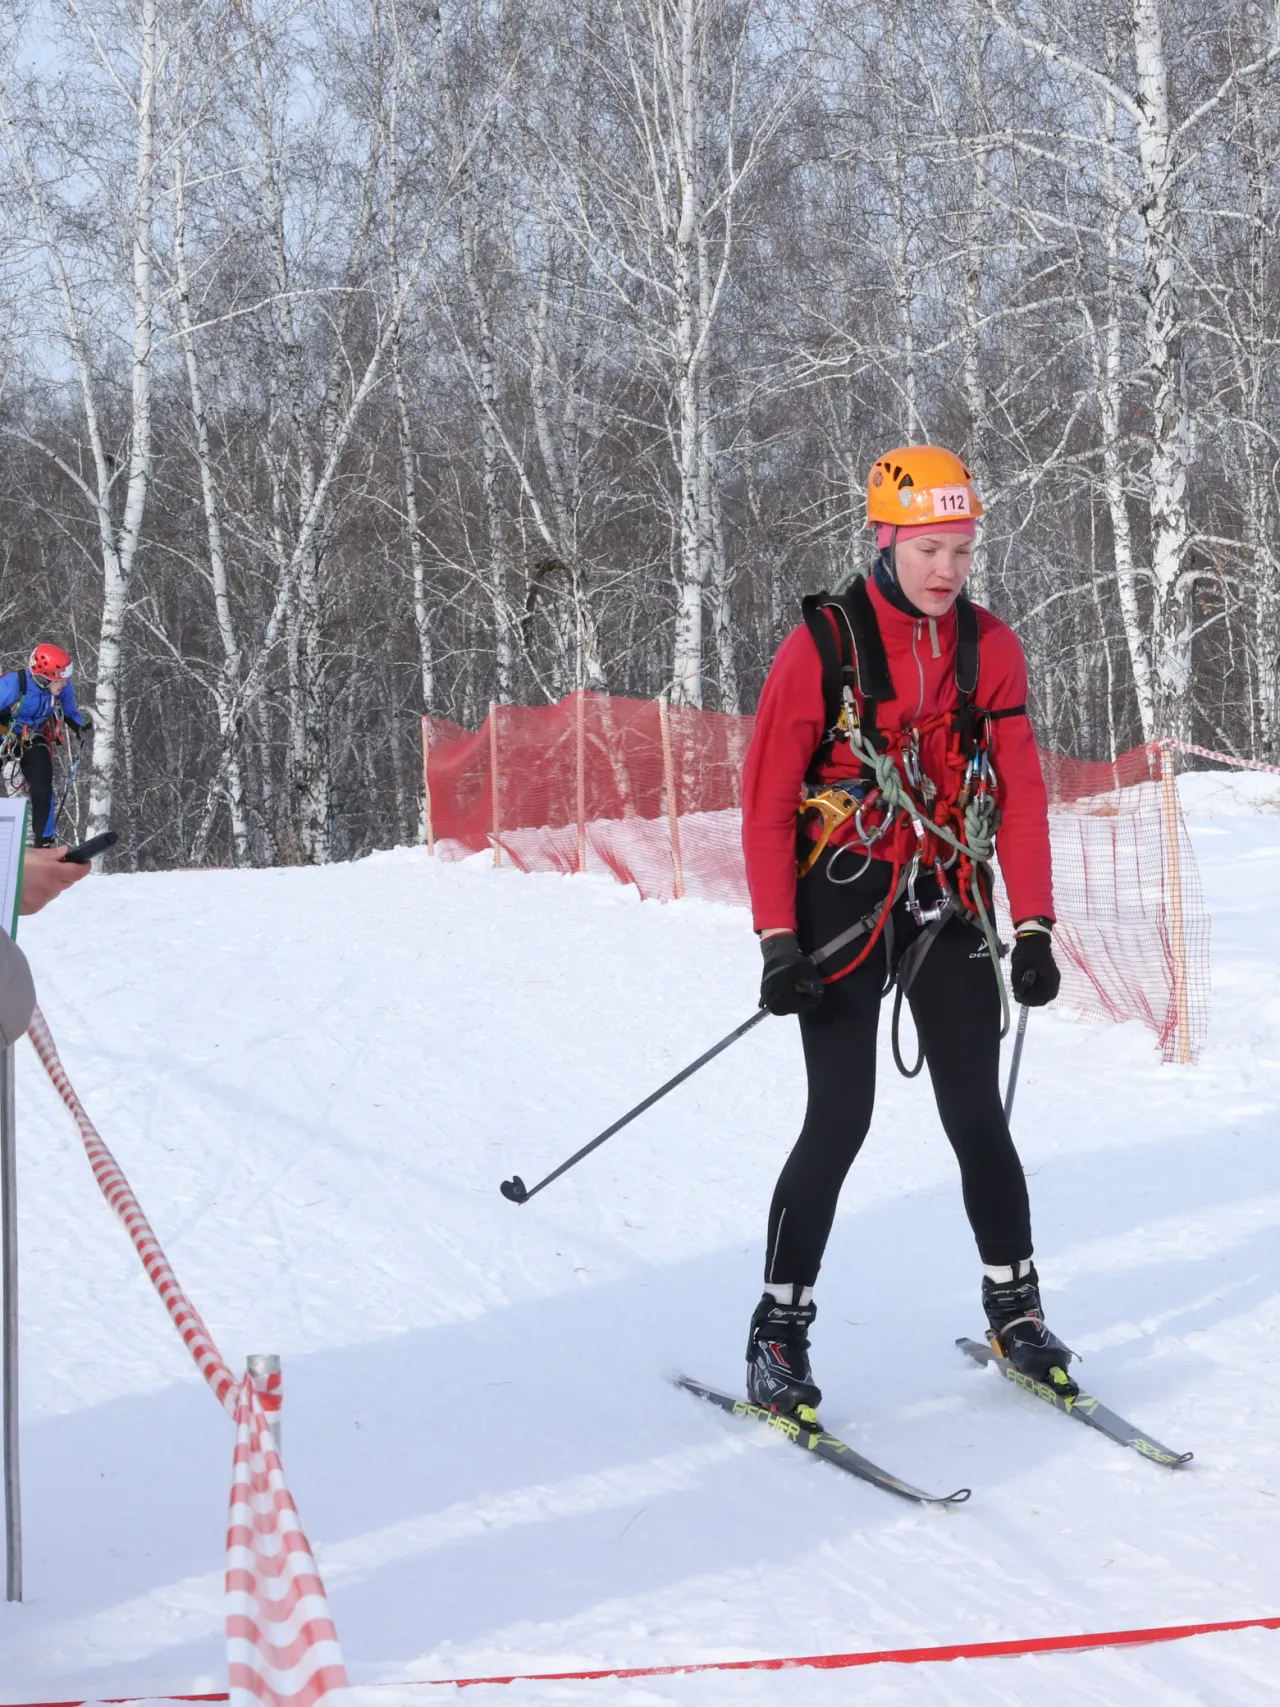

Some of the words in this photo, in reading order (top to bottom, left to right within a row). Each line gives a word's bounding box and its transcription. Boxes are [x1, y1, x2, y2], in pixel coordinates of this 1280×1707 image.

[940, 494, 965, 511] 112
[1006, 1367, 1058, 1407] FISCHER
[732, 1401, 801, 1442] FISCHER
